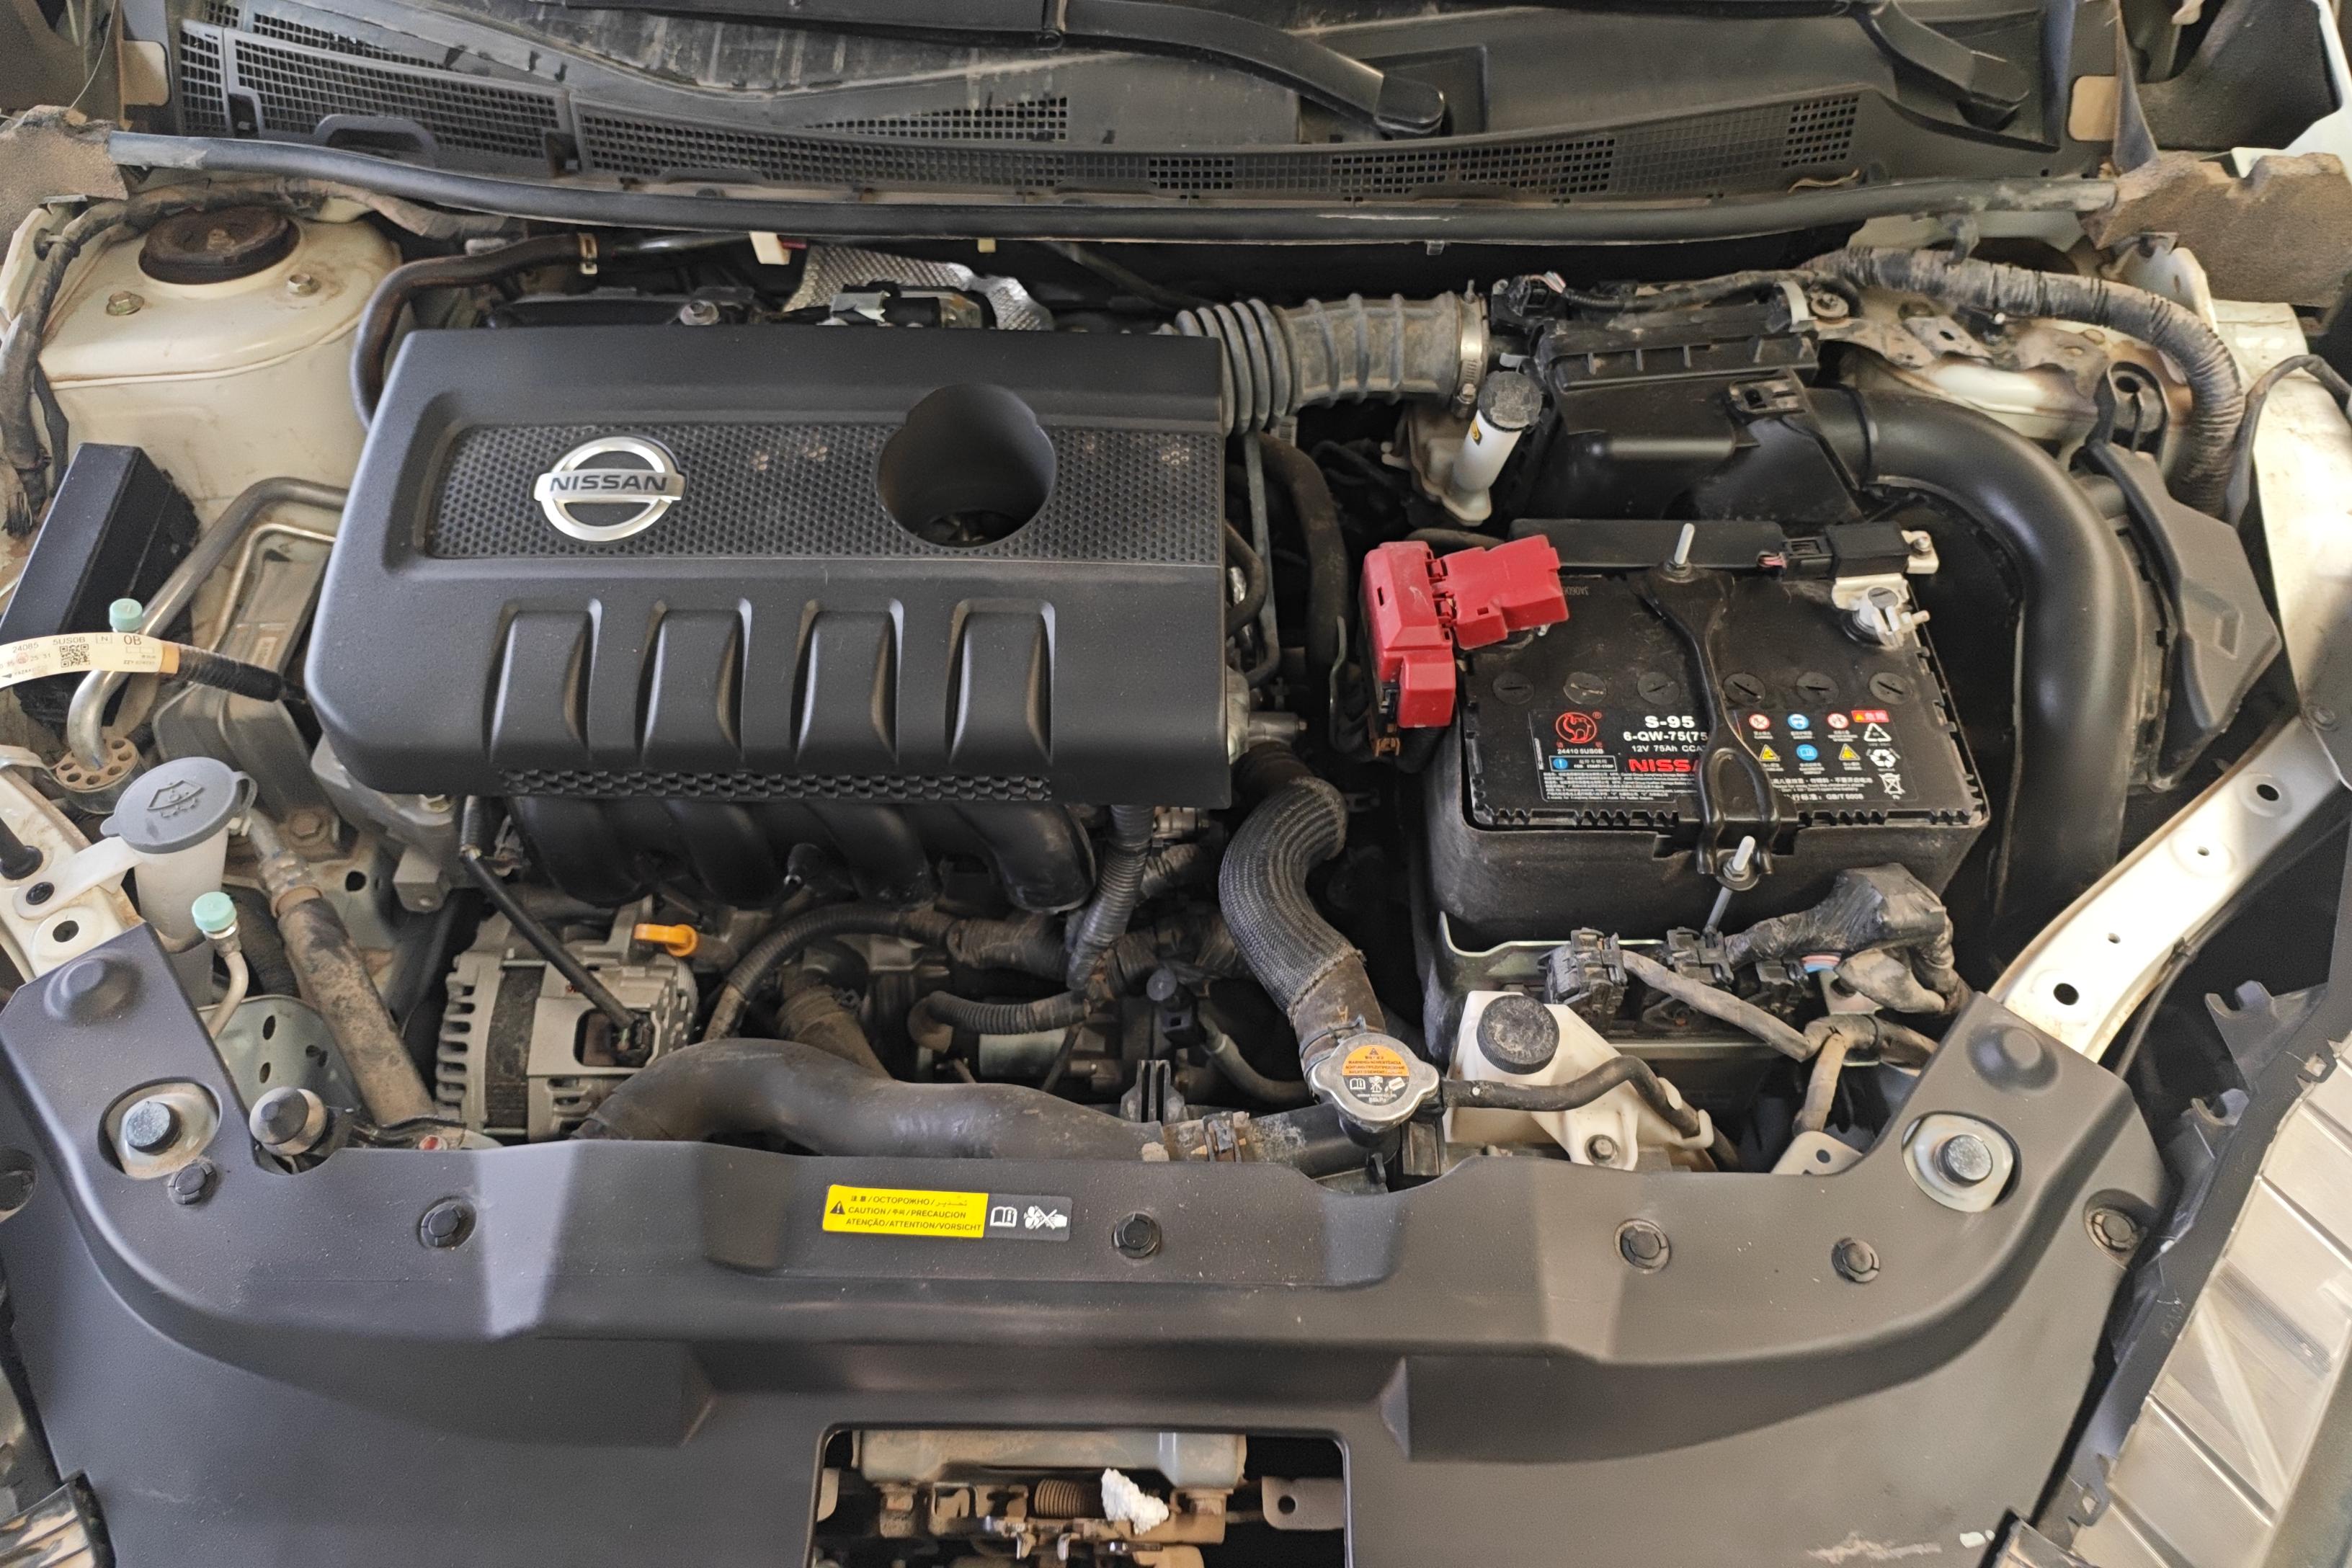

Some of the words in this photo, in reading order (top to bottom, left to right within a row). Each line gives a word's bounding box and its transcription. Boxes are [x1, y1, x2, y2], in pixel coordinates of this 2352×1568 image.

[549, 474, 668, 492] NISSAN
[1644, 716, 1696, 729] S-95
[847, 1206, 886, 1215] CAUTION
